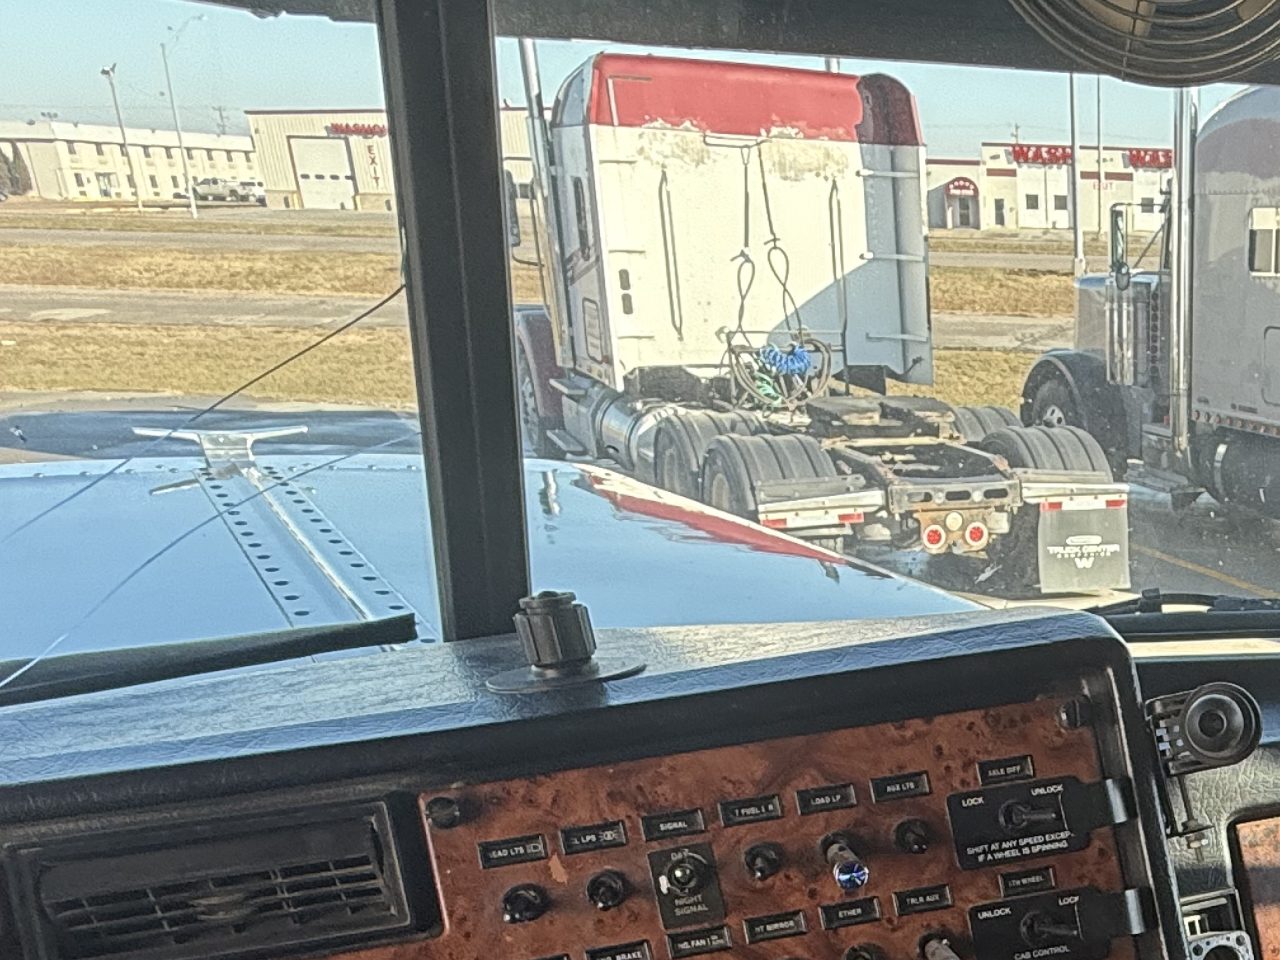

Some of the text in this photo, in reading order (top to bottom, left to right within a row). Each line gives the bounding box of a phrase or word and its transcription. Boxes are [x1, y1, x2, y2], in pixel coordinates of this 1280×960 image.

[367, 144, 380, 190] EXIT
[810, 796, 830, 805] LOAD
[961, 784, 1064, 807] LOCK UNLOCK
[659, 821, 688, 831] SIGNAL
[967, 830, 1075, 855] SHIFT AT ANY SPEED EXCEP
[510, 845, 525, 856] LTS
[671, 849, 690, 861] DAY
[994, 850, 1021, 859] WHEEL
[1031, 840, 1068, 854] SPINNING
[1021, 875, 1044, 885] WHEEL
[674, 894, 703, 906] NIGHT
[674, 903, 709, 916] SIGNAL
[838, 907, 862, 918] ETHER
[978, 896, 1079, 920] UNLOCK LOCK
[691, 938, 706, 948] FAN
[1014, 945, 1071, 960] CAB CONTROL
